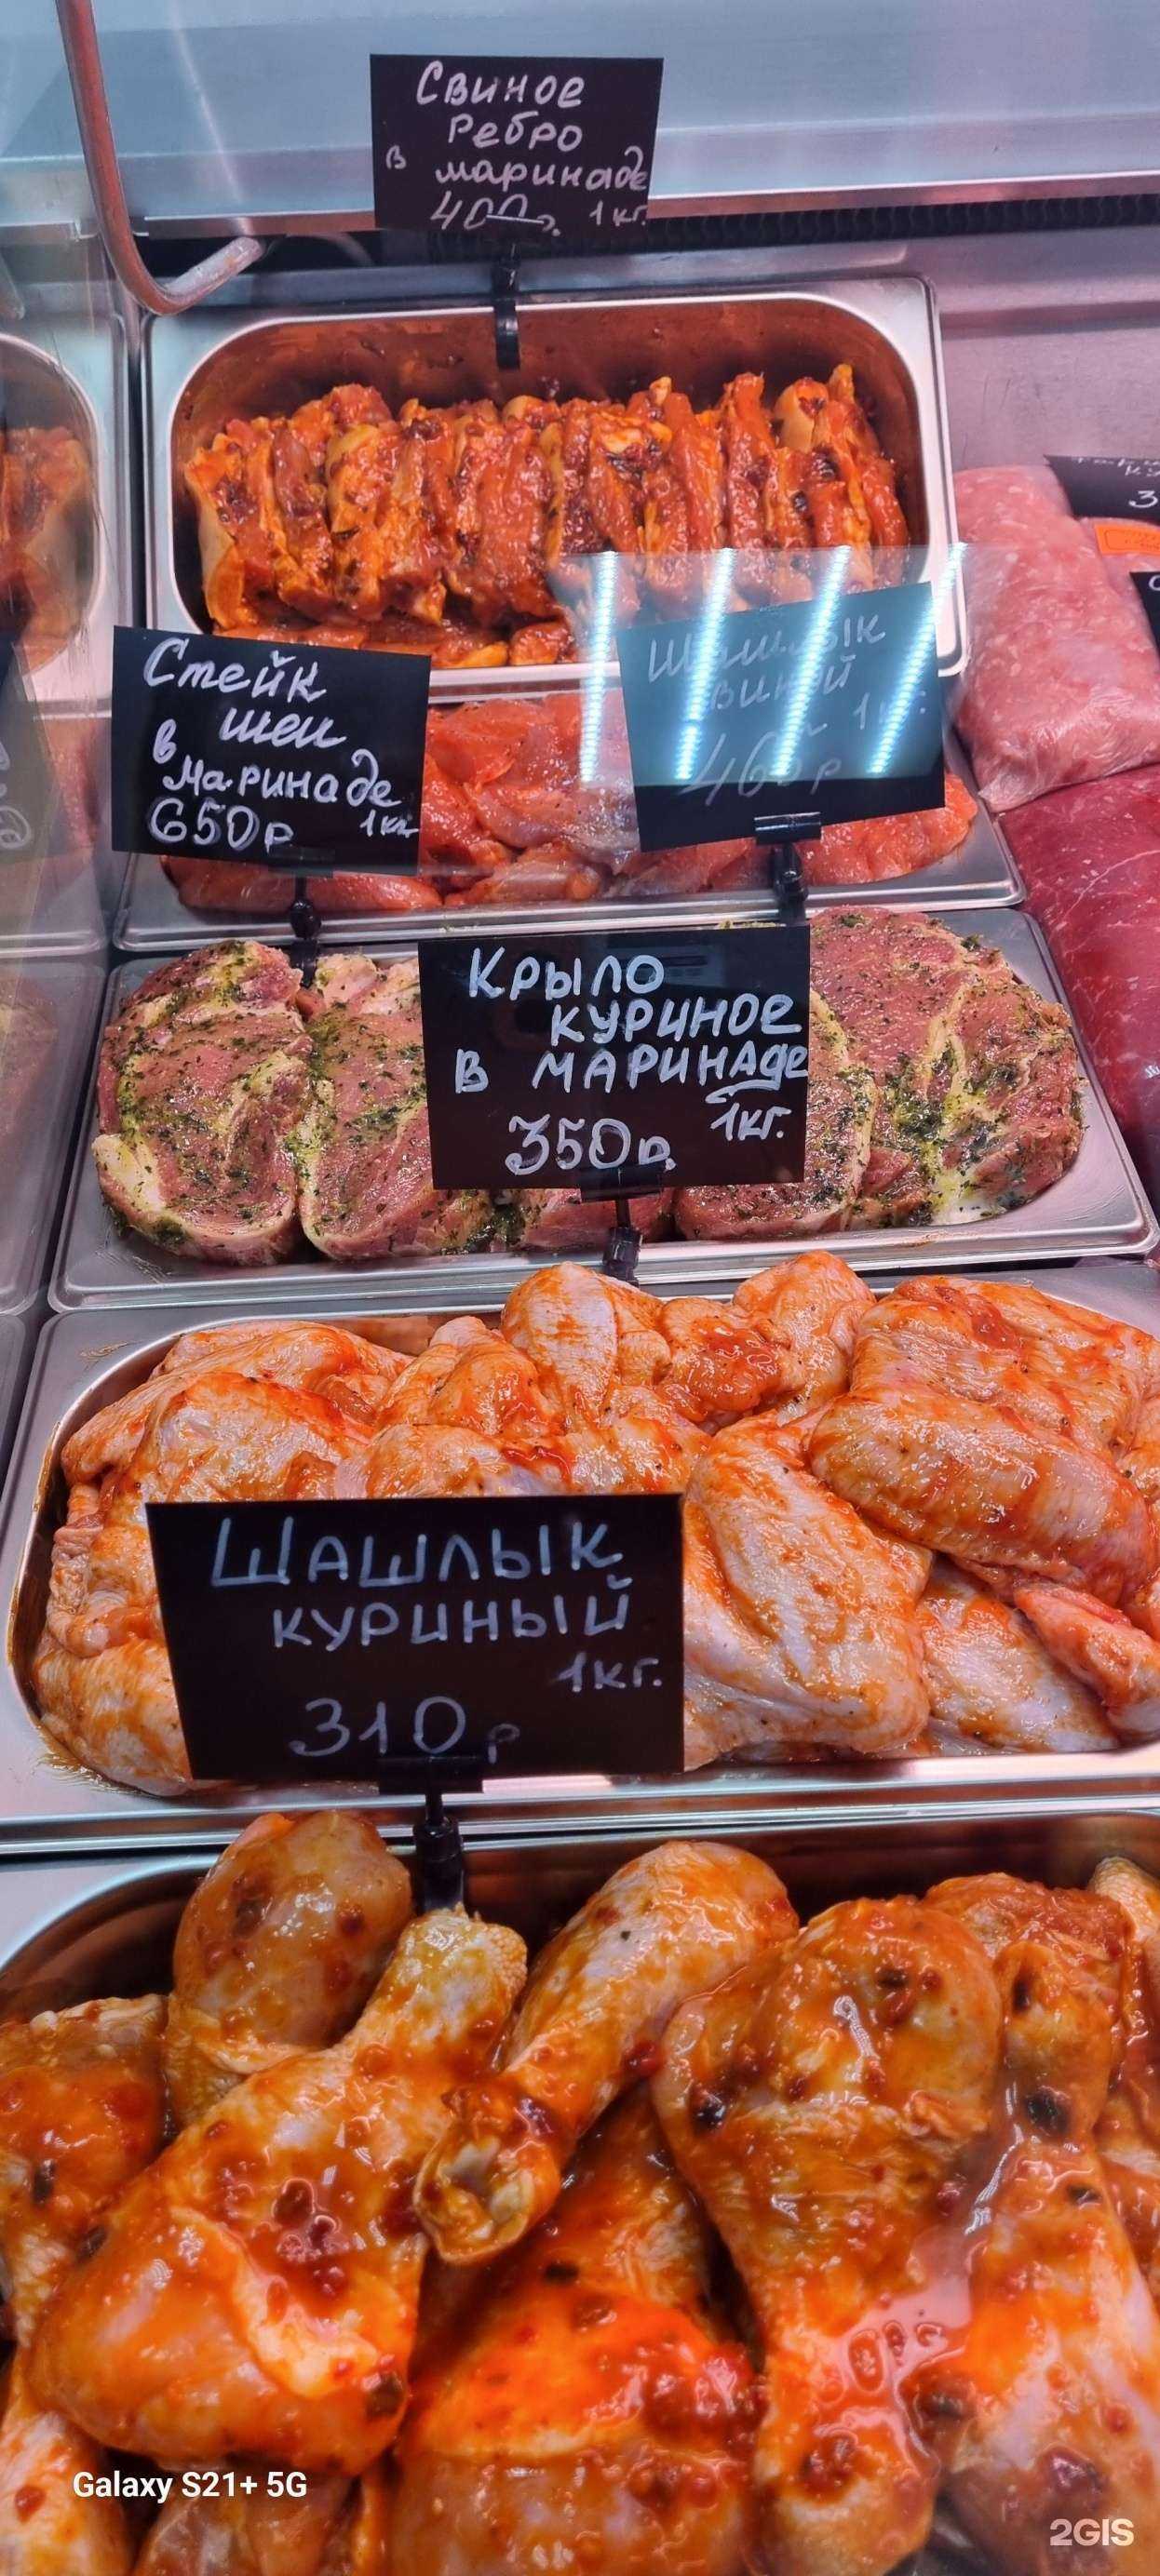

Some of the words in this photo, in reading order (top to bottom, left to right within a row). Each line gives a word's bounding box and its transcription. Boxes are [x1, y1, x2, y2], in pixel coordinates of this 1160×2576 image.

[417, 60, 585, 109] Свиное
[435, 145, 647, 192] маринаде
[144, 638, 327, 703] Стейк
[220, 707, 346, 748] шеи
